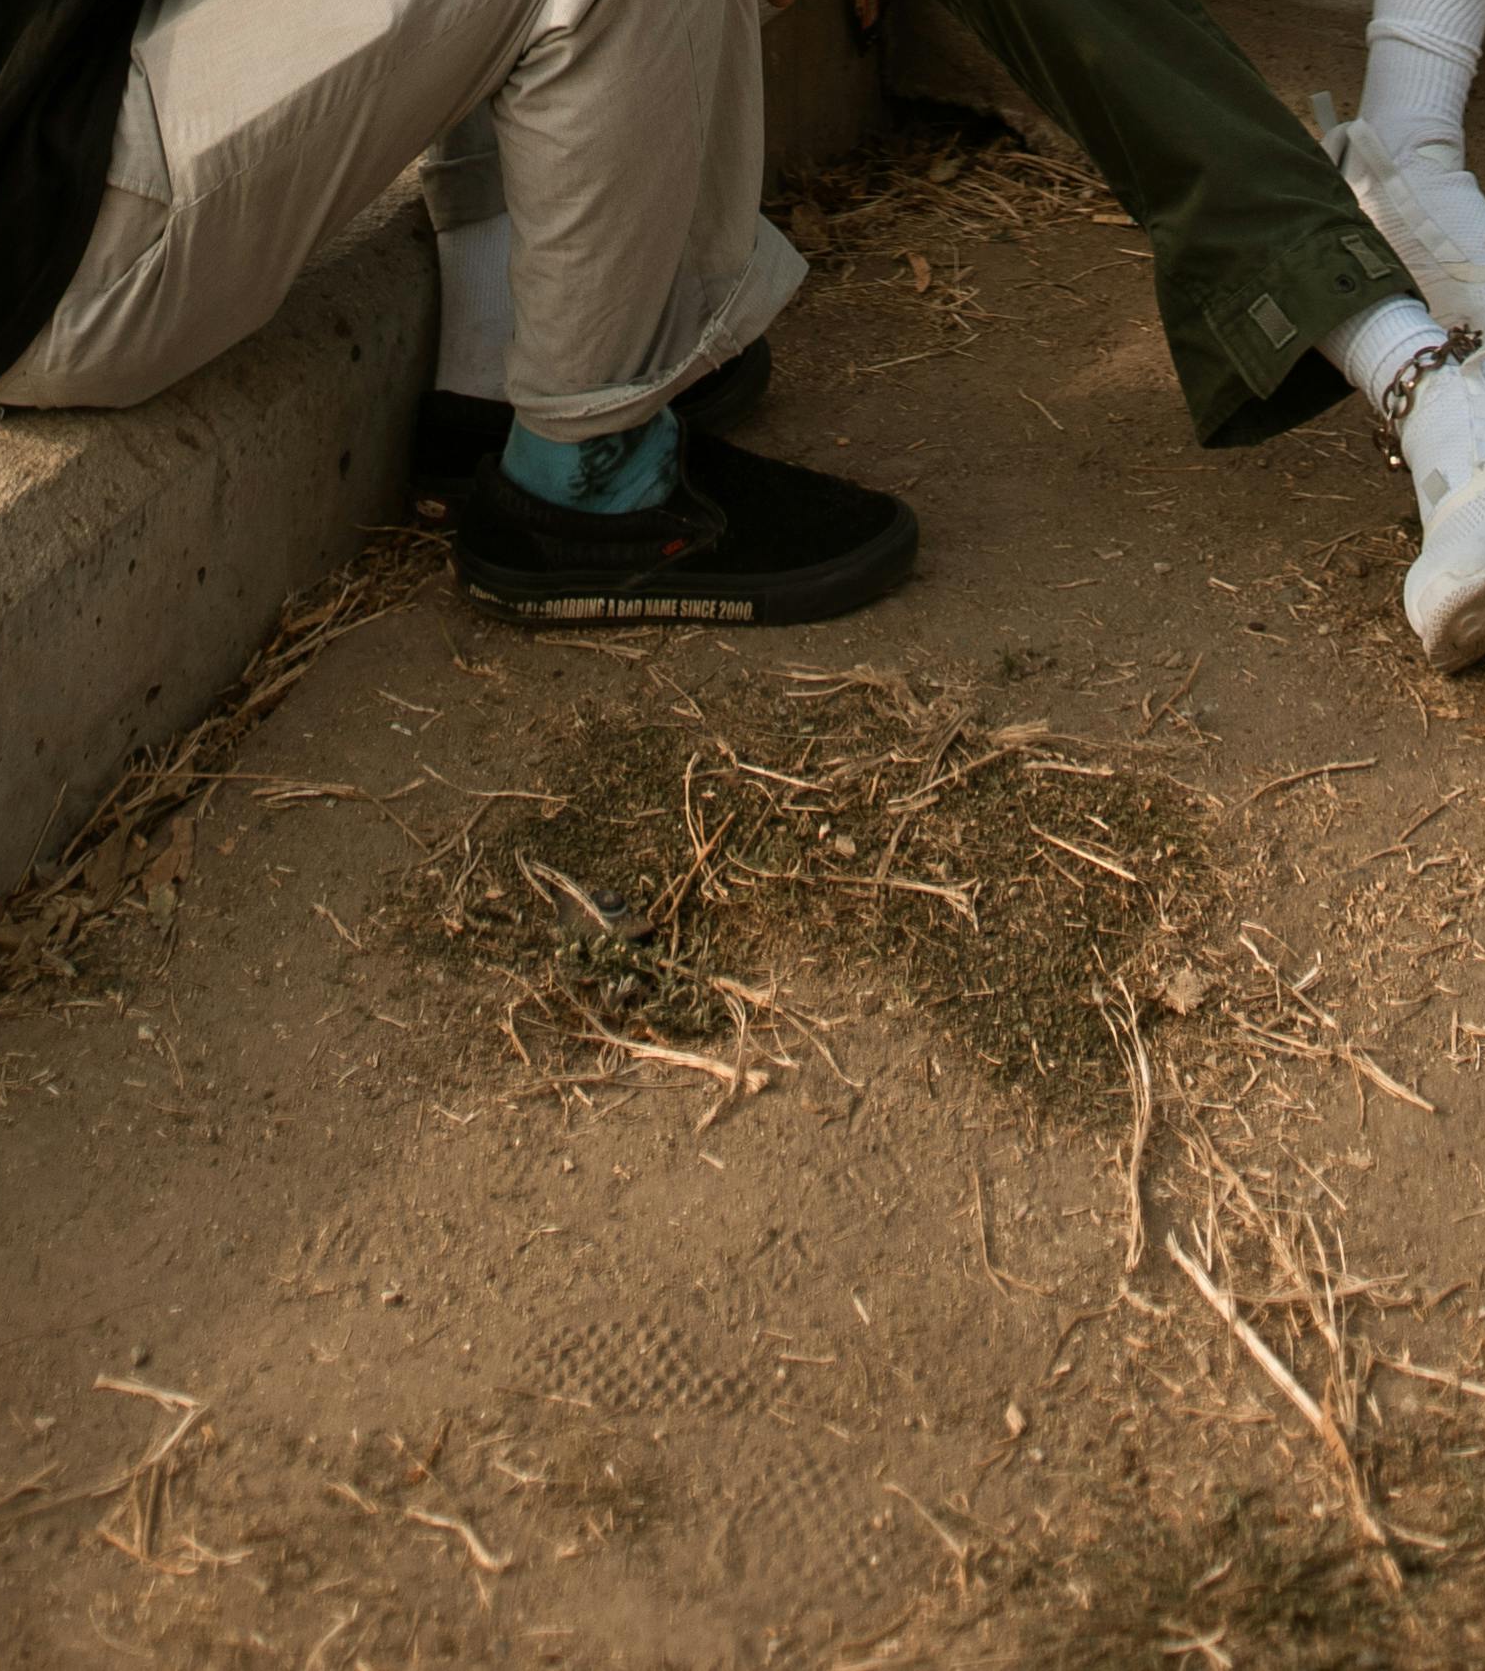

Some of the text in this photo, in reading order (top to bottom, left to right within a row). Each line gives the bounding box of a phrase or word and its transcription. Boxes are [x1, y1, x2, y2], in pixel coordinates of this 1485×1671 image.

[606, 598, 615, 618] A
[617, 598, 643, 618] BAD
[644, 598, 678, 618] NAME
[680, 599, 716, 619] SINCE
